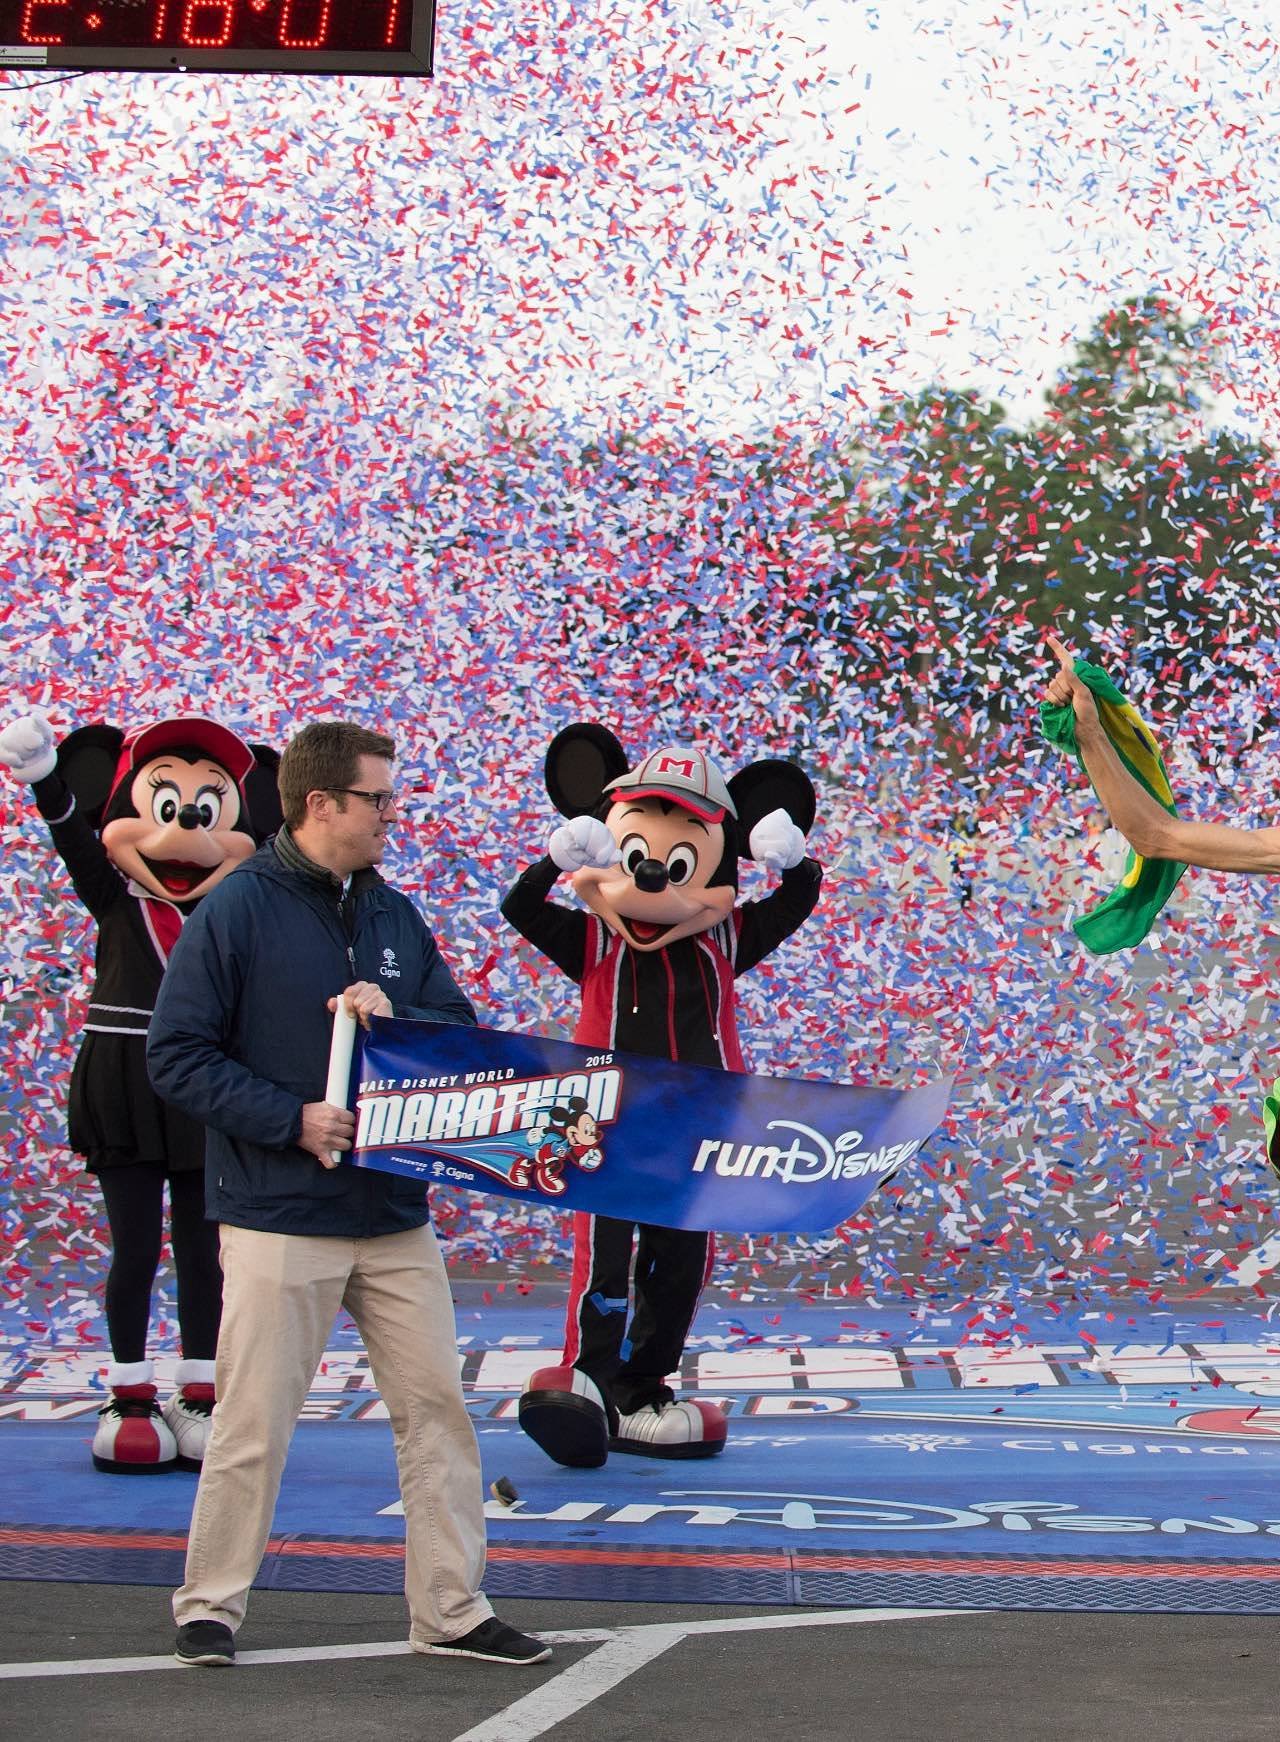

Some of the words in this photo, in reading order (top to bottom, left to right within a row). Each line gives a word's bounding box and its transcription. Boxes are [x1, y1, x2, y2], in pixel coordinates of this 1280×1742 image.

[656, 756, 697, 779] M
[380, 966, 401, 979] Cigna
[585, 1053, 613, 1069] 2015
[358, 1078, 396, 1094] WALT
[401, 1075, 459, 1090] DISNEY
[464, 1068, 515, 1083] WORLD
[355, 1069, 621, 1149] MARATHON
[445, 1167, 475, 1181] Cigna
[1001, 1439, 1251, 1455] Cigna
